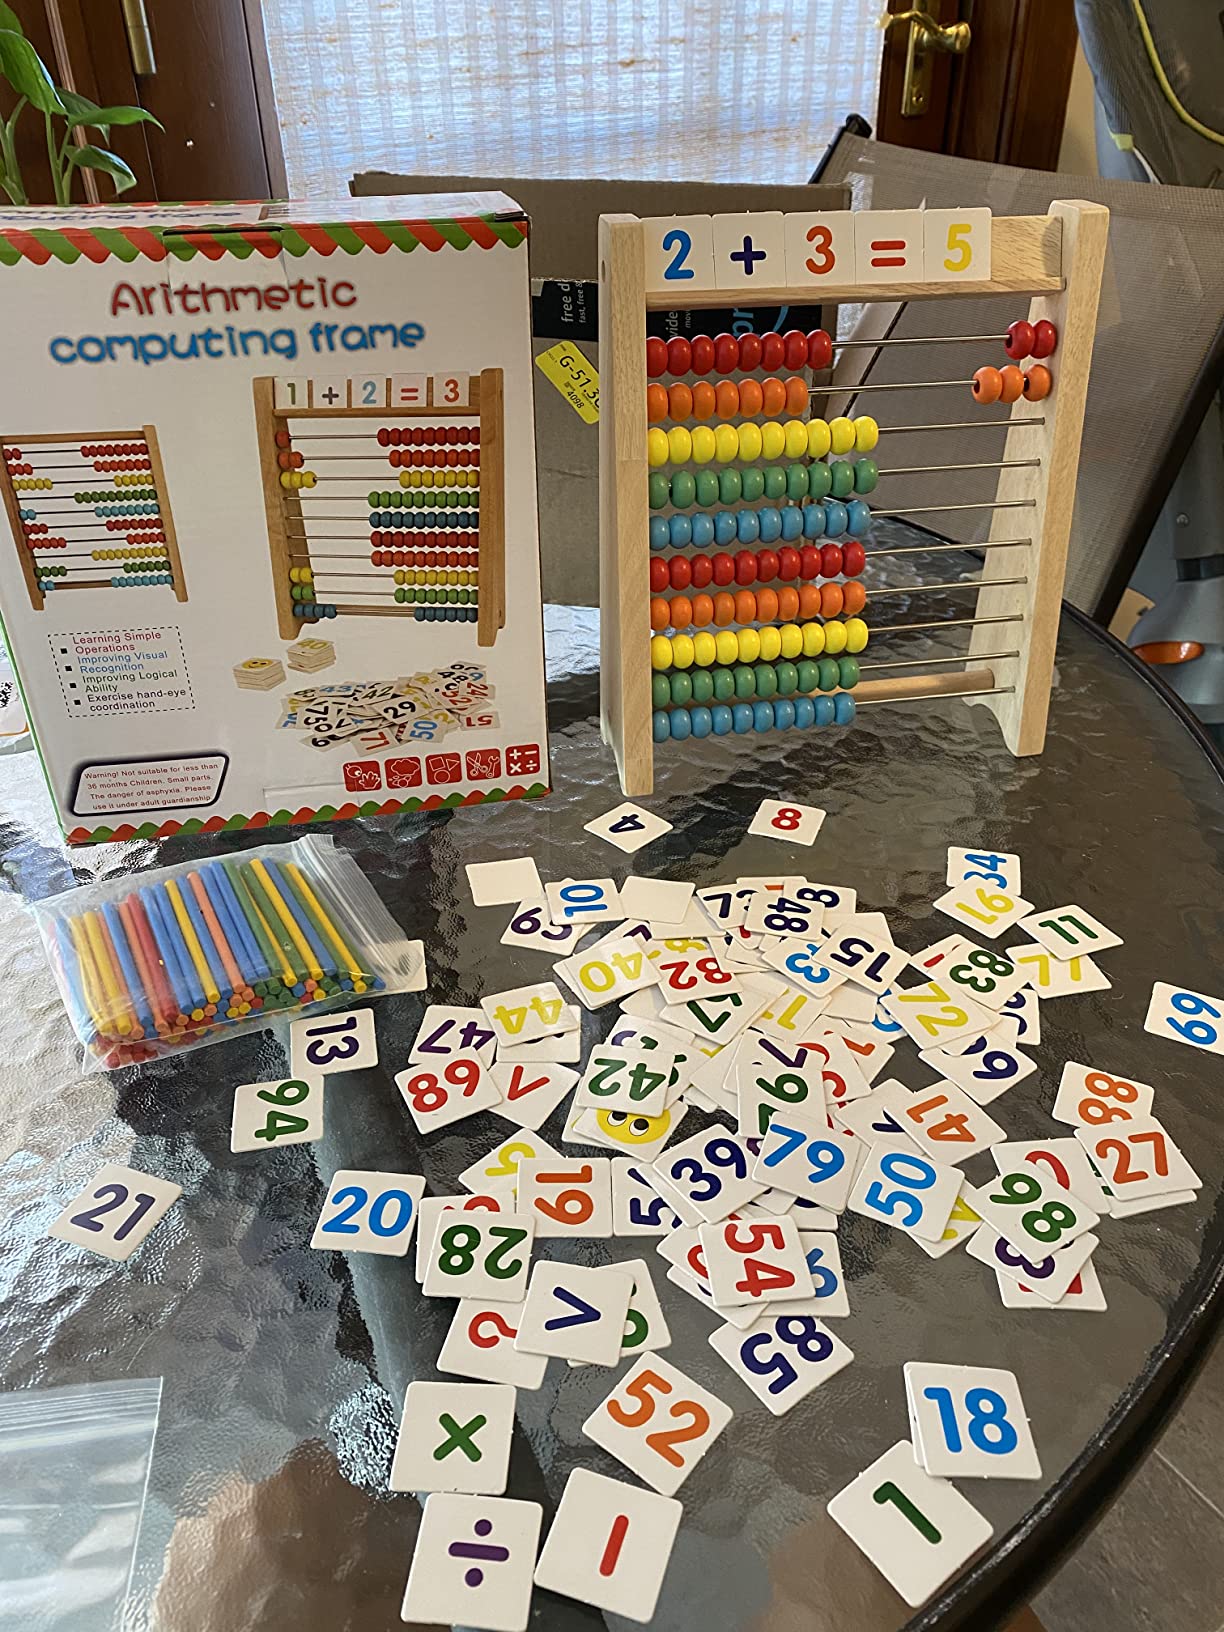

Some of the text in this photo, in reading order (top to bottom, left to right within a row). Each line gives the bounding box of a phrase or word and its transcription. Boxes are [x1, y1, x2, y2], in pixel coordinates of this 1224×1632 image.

[662, 224, 972, 280] 2 + 3 = 5
[111, 277, 358, 317] Arithmetic
[561, 295, 574, 323] free
[665, 310, 679, 338] vide
[50, 321, 426, 365] computing frame
[287, 382, 296, 405] 1
[362, 380, 377, 404] 2
[444, 379, 460, 403] 3
[566, 389, 585, 410] 4098
[73, 631, 162, 645] Learning Simple
[75, 643, 136, 655] Operations
[77, 651, 168, 665] Improving Visual
[80, 663, 144, 674] Recognition
[82, 669, 178, 684] Improving Logical
[85, 684, 118, 693] Ability
[87, 689, 186, 702] Exercise hand-eye
[90, 700, 156, 712] coordination
[383, 701, 416, 720] 29
[409, 720, 438, 740] 50
[84, 771, 119, 779] Warning!
[138, 767, 168, 775] suitable
[99, 781, 128, 789] months
[167, 776, 189, 784] Small
[107, 791, 134, 799] danger
[184, 784, 211, 792] Please
[161, 794, 211, 805] guardianship
[608, 813, 646, 834] 4
[770, 807, 803, 831] 8
[560, 884, 608, 917] 10
[1038, 914, 1099, 945] 11
[492, 996, 564, 1035] 44
[304, 1016, 360, 1066] 13
[588, 1058, 667, 1102] 42
[763, 1123, 846, 1184] 79
[1095, 1131, 1169, 1185] 27
[670, 1138, 748, 1202] 39
[865, 1152, 937, 1228] 50
[70, 1183, 156, 1242] 21
[320, 1185, 414, 1238] 20
[723, 1223, 796, 1298] 54
[606, 1369, 711, 1469] 52
[923, 1387, 1018, 1456] 18
[873, 1481, 942, 1545] 1
